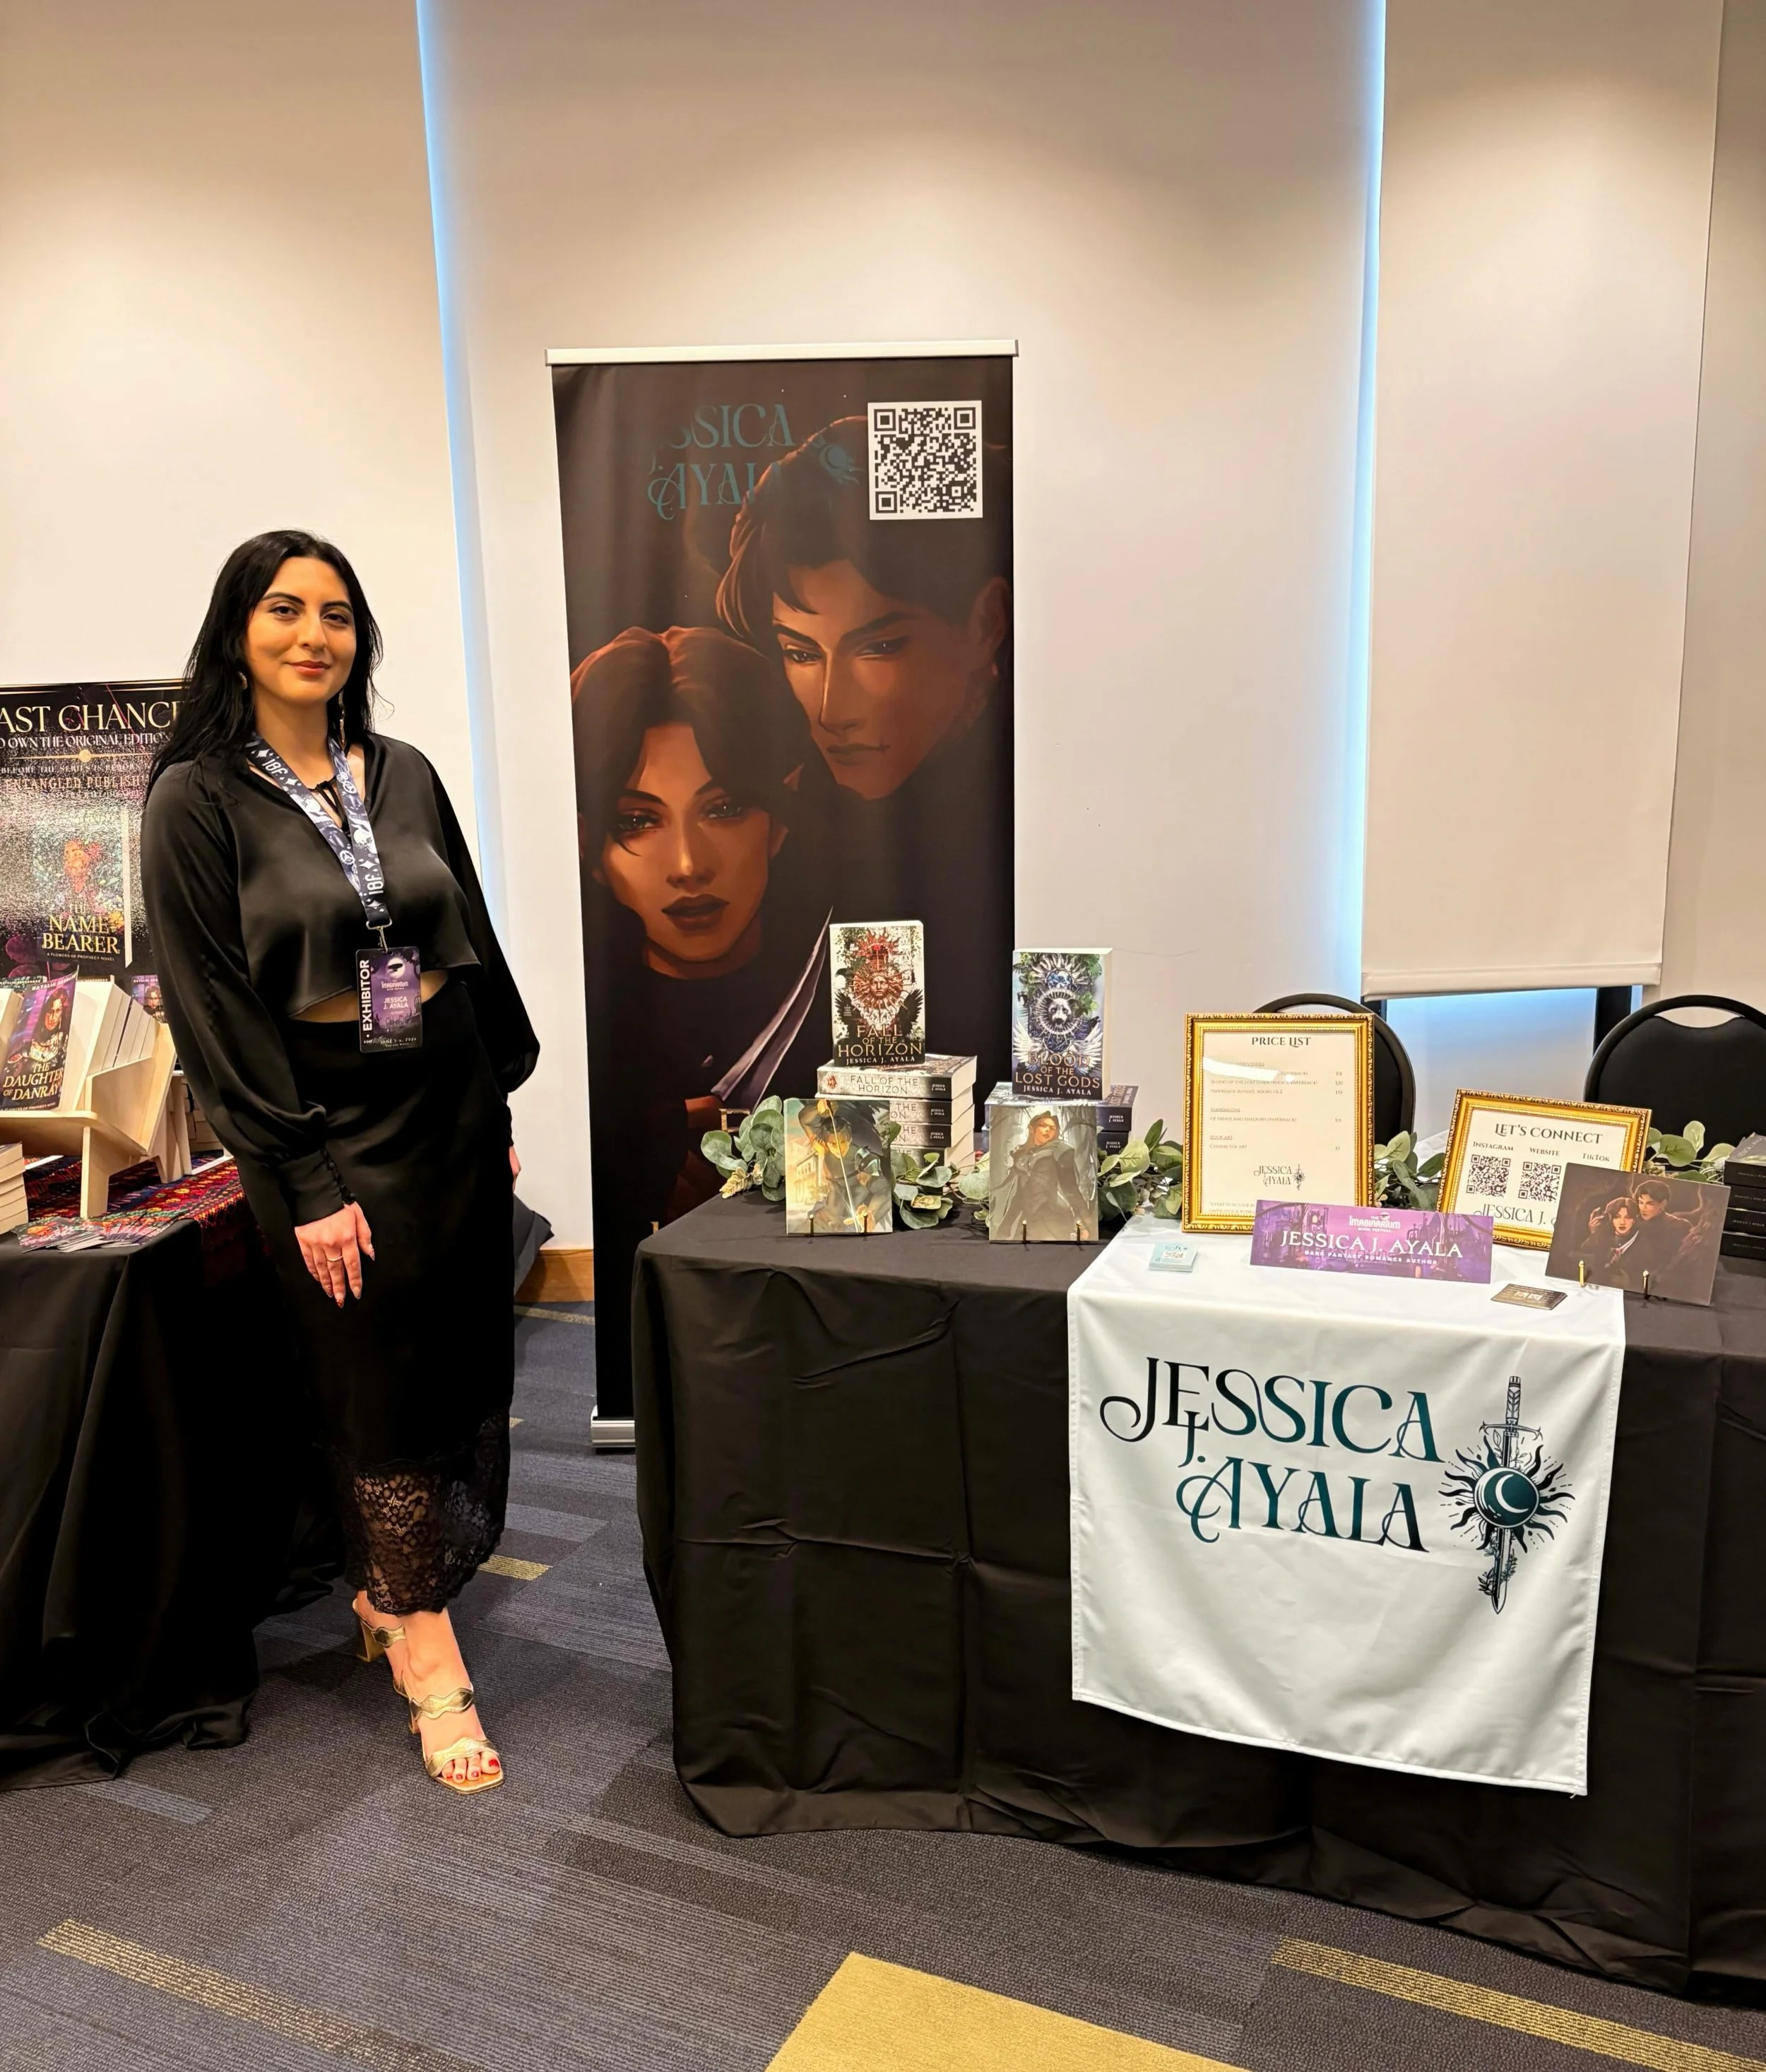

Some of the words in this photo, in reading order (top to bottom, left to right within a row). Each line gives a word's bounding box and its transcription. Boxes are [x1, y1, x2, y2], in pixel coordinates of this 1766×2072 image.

[648, 462, 781, 521] AYAL
[0, 706, 50, 733] AST
[8, 736, 38, 749] OWN
[40, 735, 64, 747] THE
[66, 733, 122, 747] ORIGINAL
[4, 777, 81, 791] ENTANGLED
[42, 933, 120, 954] BEARER
[359, 959, 373, 1031] EXHIBITOR
[857, 1024, 903, 1038] FALL
[838, 1042, 922, 1058] HORIZON
[1251, 1036, 1286, 1046] PRICE
[1288, 1036, 1312, 1048] LIST
[1028, 1051, 1090, 1067] BLOOD
[32, 1062, 50, 1073] THE
[1055, 1067, 1074, 1075] THE
[850, 1075, 877, 1084] FALL
[879, 1077, 894, 1085] OF
[897, 1077, 918, 1087] THE
[1015, 1072, 1053, 1085] LOST
[1057, 1075, 1101, 1089] GODS
[858, 1084, 908, 1094] HORIZON
[897, 1103, 917, 1112] THE
[903, 1126, 917, 1135] HE
[1495, 1123, 1527, 1137] LET'S
[1530, 1127, 1604, 1144] CONNECT
[1473, 1141, 1514, 1152] INSTAGRAM
[1529, 1147, 1560, 1156] WEBSITE
[1253, 1165, 1293, 1177] JESSICA
[1262, 1176, 1291, 1187] AYALA
[1474, 1204, 1534, 1223] JESSICA
[1539, 1211, 1547, 1224] J.
[1281, 1231, 1365, 1250] JESSICA
[1370, 1237, 1382, 1254] J.
[1389, 1239, 1464, 1258] AYALA
[1100, 1357, 1445, 1464] JESSICA
[1178, 1411, 1206, 1467] J.
[1175, 1456, 1430, 1553] AYALA
